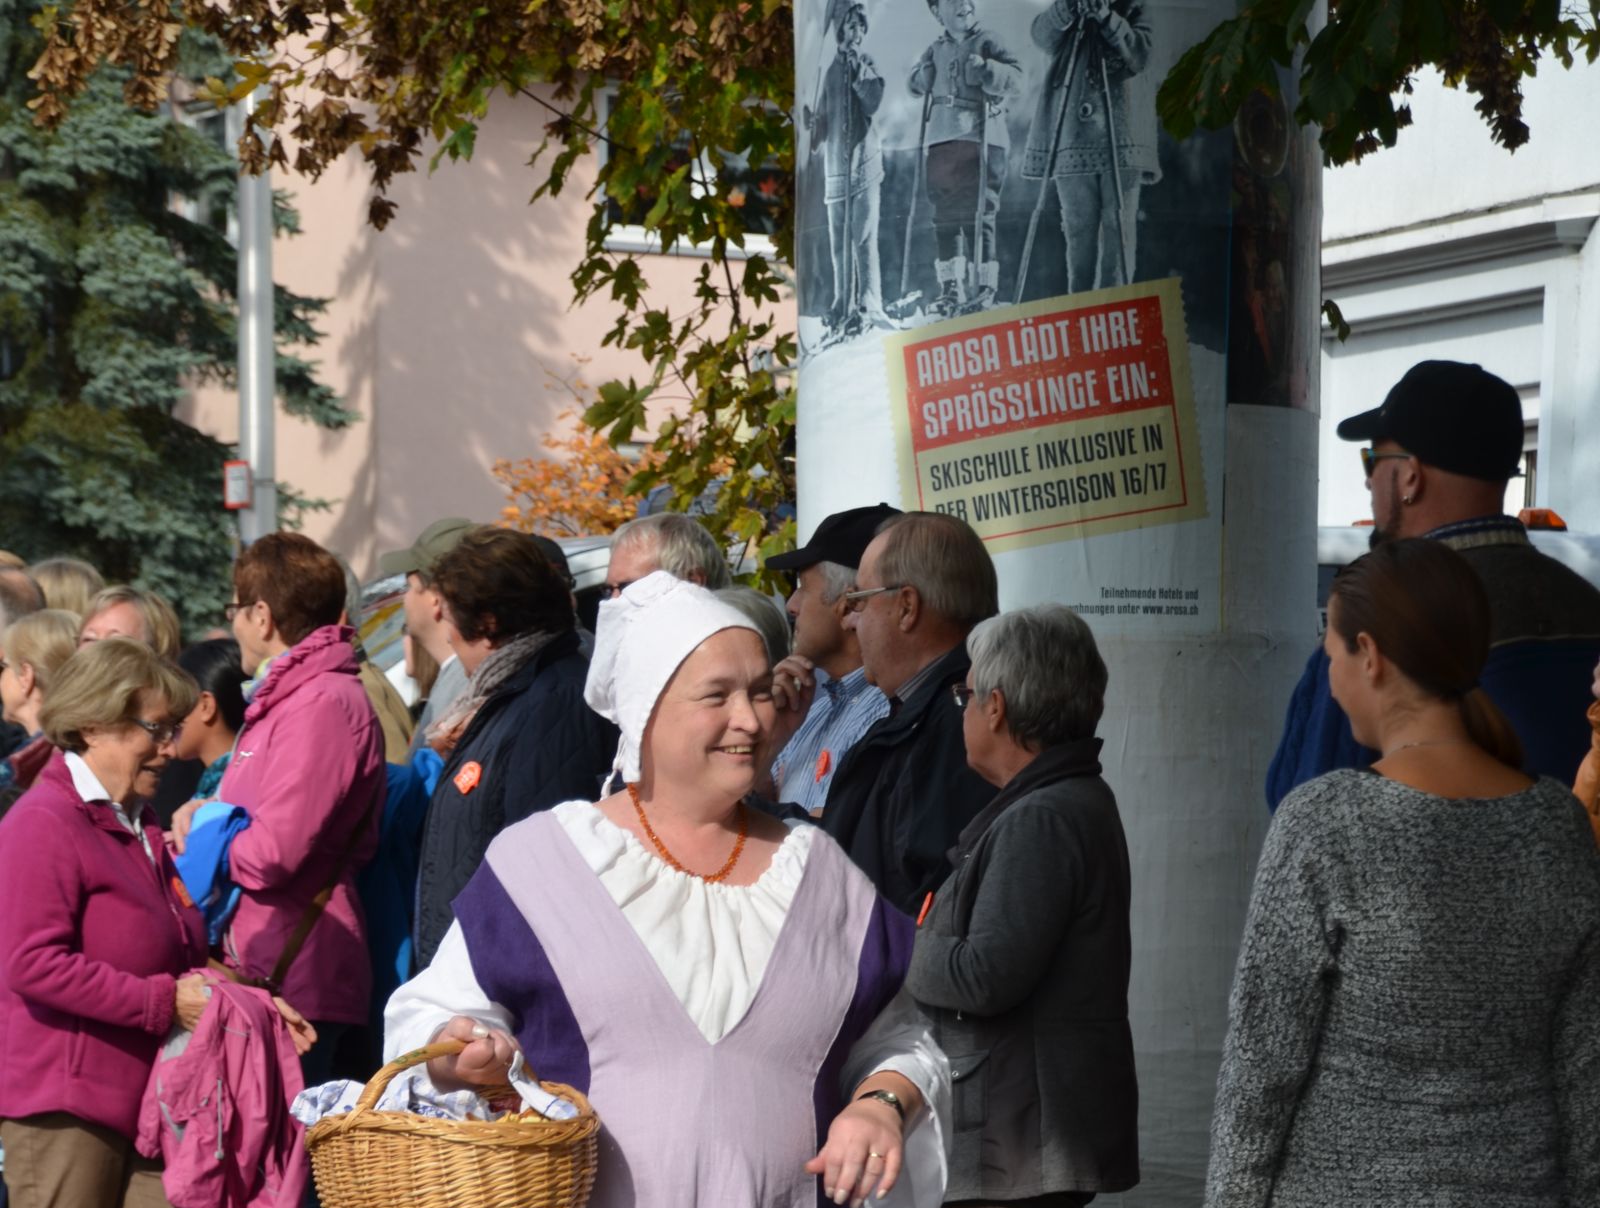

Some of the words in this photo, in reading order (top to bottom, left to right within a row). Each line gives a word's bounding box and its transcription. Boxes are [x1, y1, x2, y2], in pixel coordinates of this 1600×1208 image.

[916, 334, 1000, 388] AROSA
[1007, 318, 1071, 367] LÄDT
[1080, 308, 1142, 354] IHRE
[922, 369, 1100, 440] SPRÖSSLINGE
[1106, 361, 1159, 404] EIN:
[930, 446, 1032, 492] SKISCHULE
[1036, 428, 1138, 471] INKLUSIVE
[1142, 424, 1164, 452] IN
[972, 471, 1117, 522] WINTERSAISON
[1121, 463, 1168, 496] 16/17
[1100, 587, 1157, 600] Teilnehmende
[1158, 588, 1183, 600] Hotels
[1184, 589, 1199, 600] und
[1117, 604, 1141, 615] unter
[1142, 604, 1199, 616] www.arosa.ch
